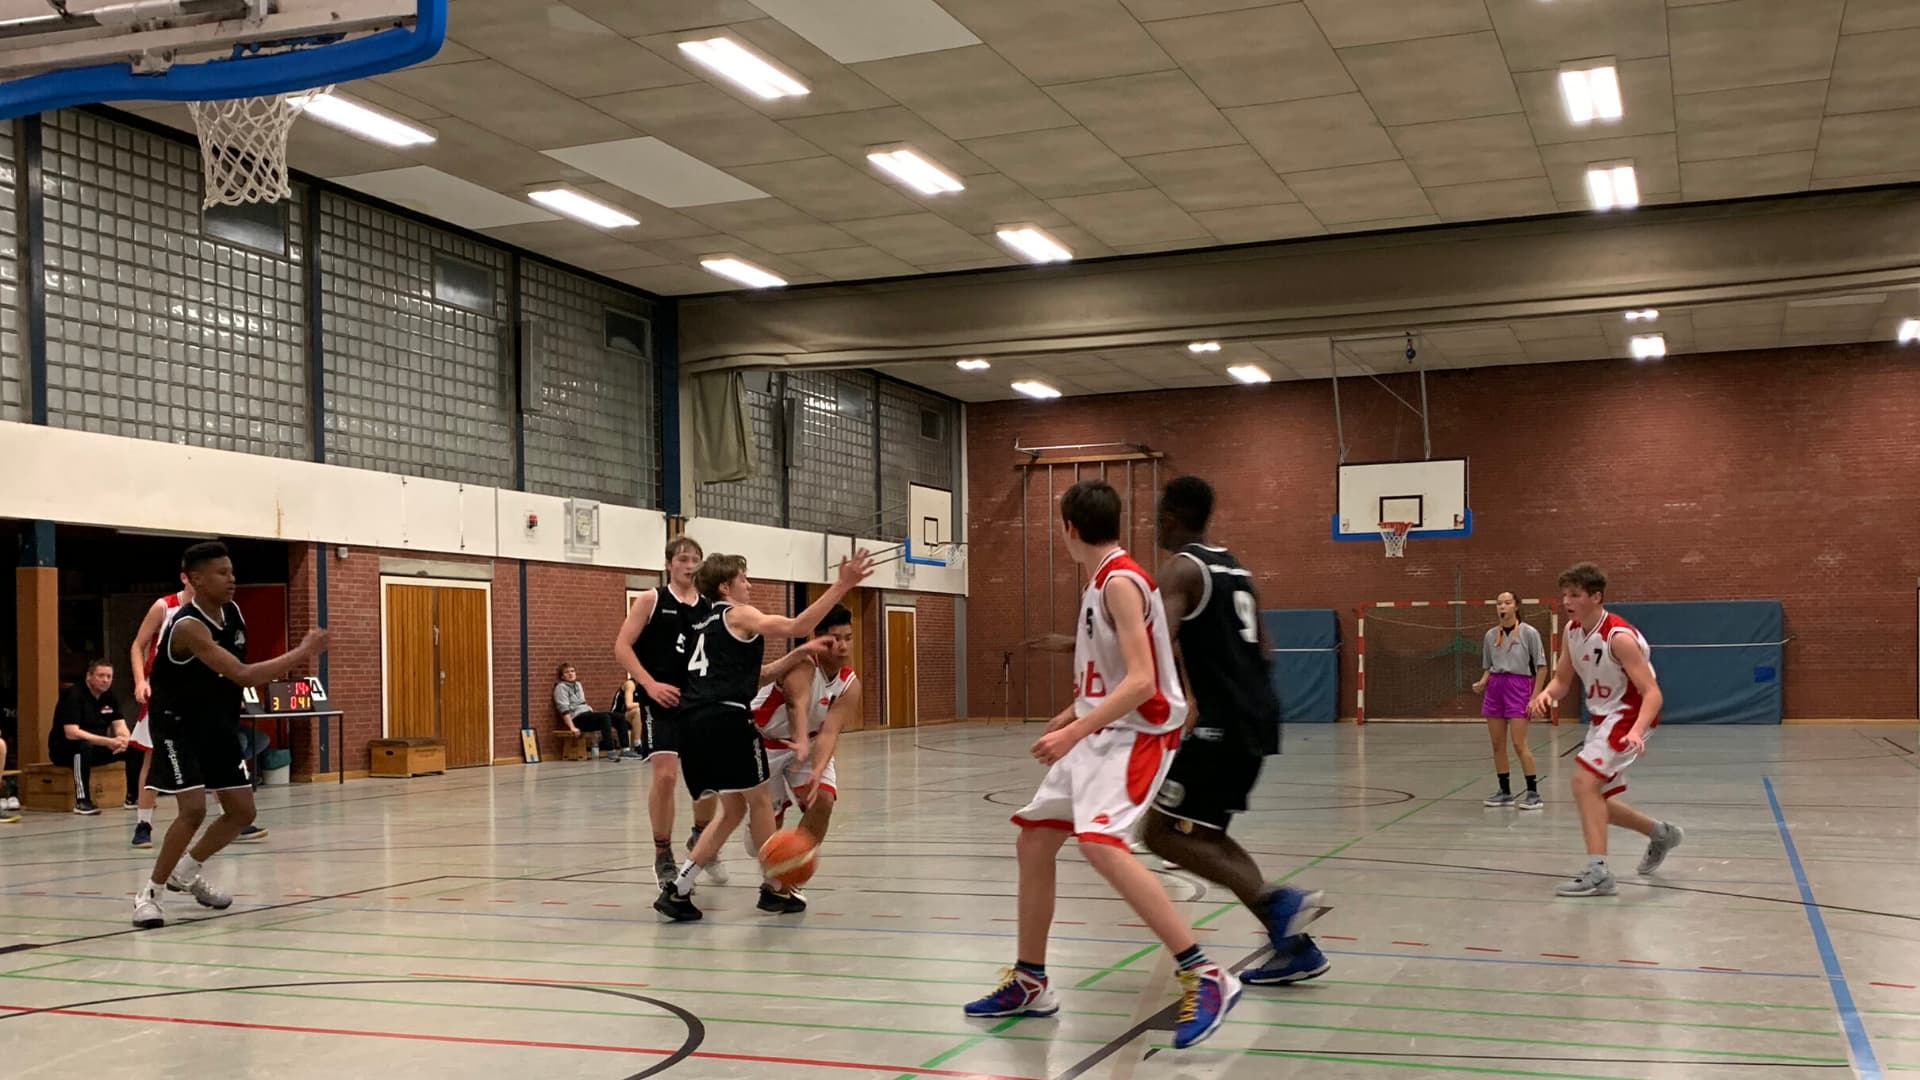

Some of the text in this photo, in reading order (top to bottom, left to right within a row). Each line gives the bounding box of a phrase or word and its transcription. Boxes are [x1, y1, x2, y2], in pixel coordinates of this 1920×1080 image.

[1233, 590, 1258, 643] 9
[688, 633, 709, 676] 4
[1594, 648, 1603, 667] 7
[311, 680, 323, 697] 4
[272, 696, 279, 710] 3
